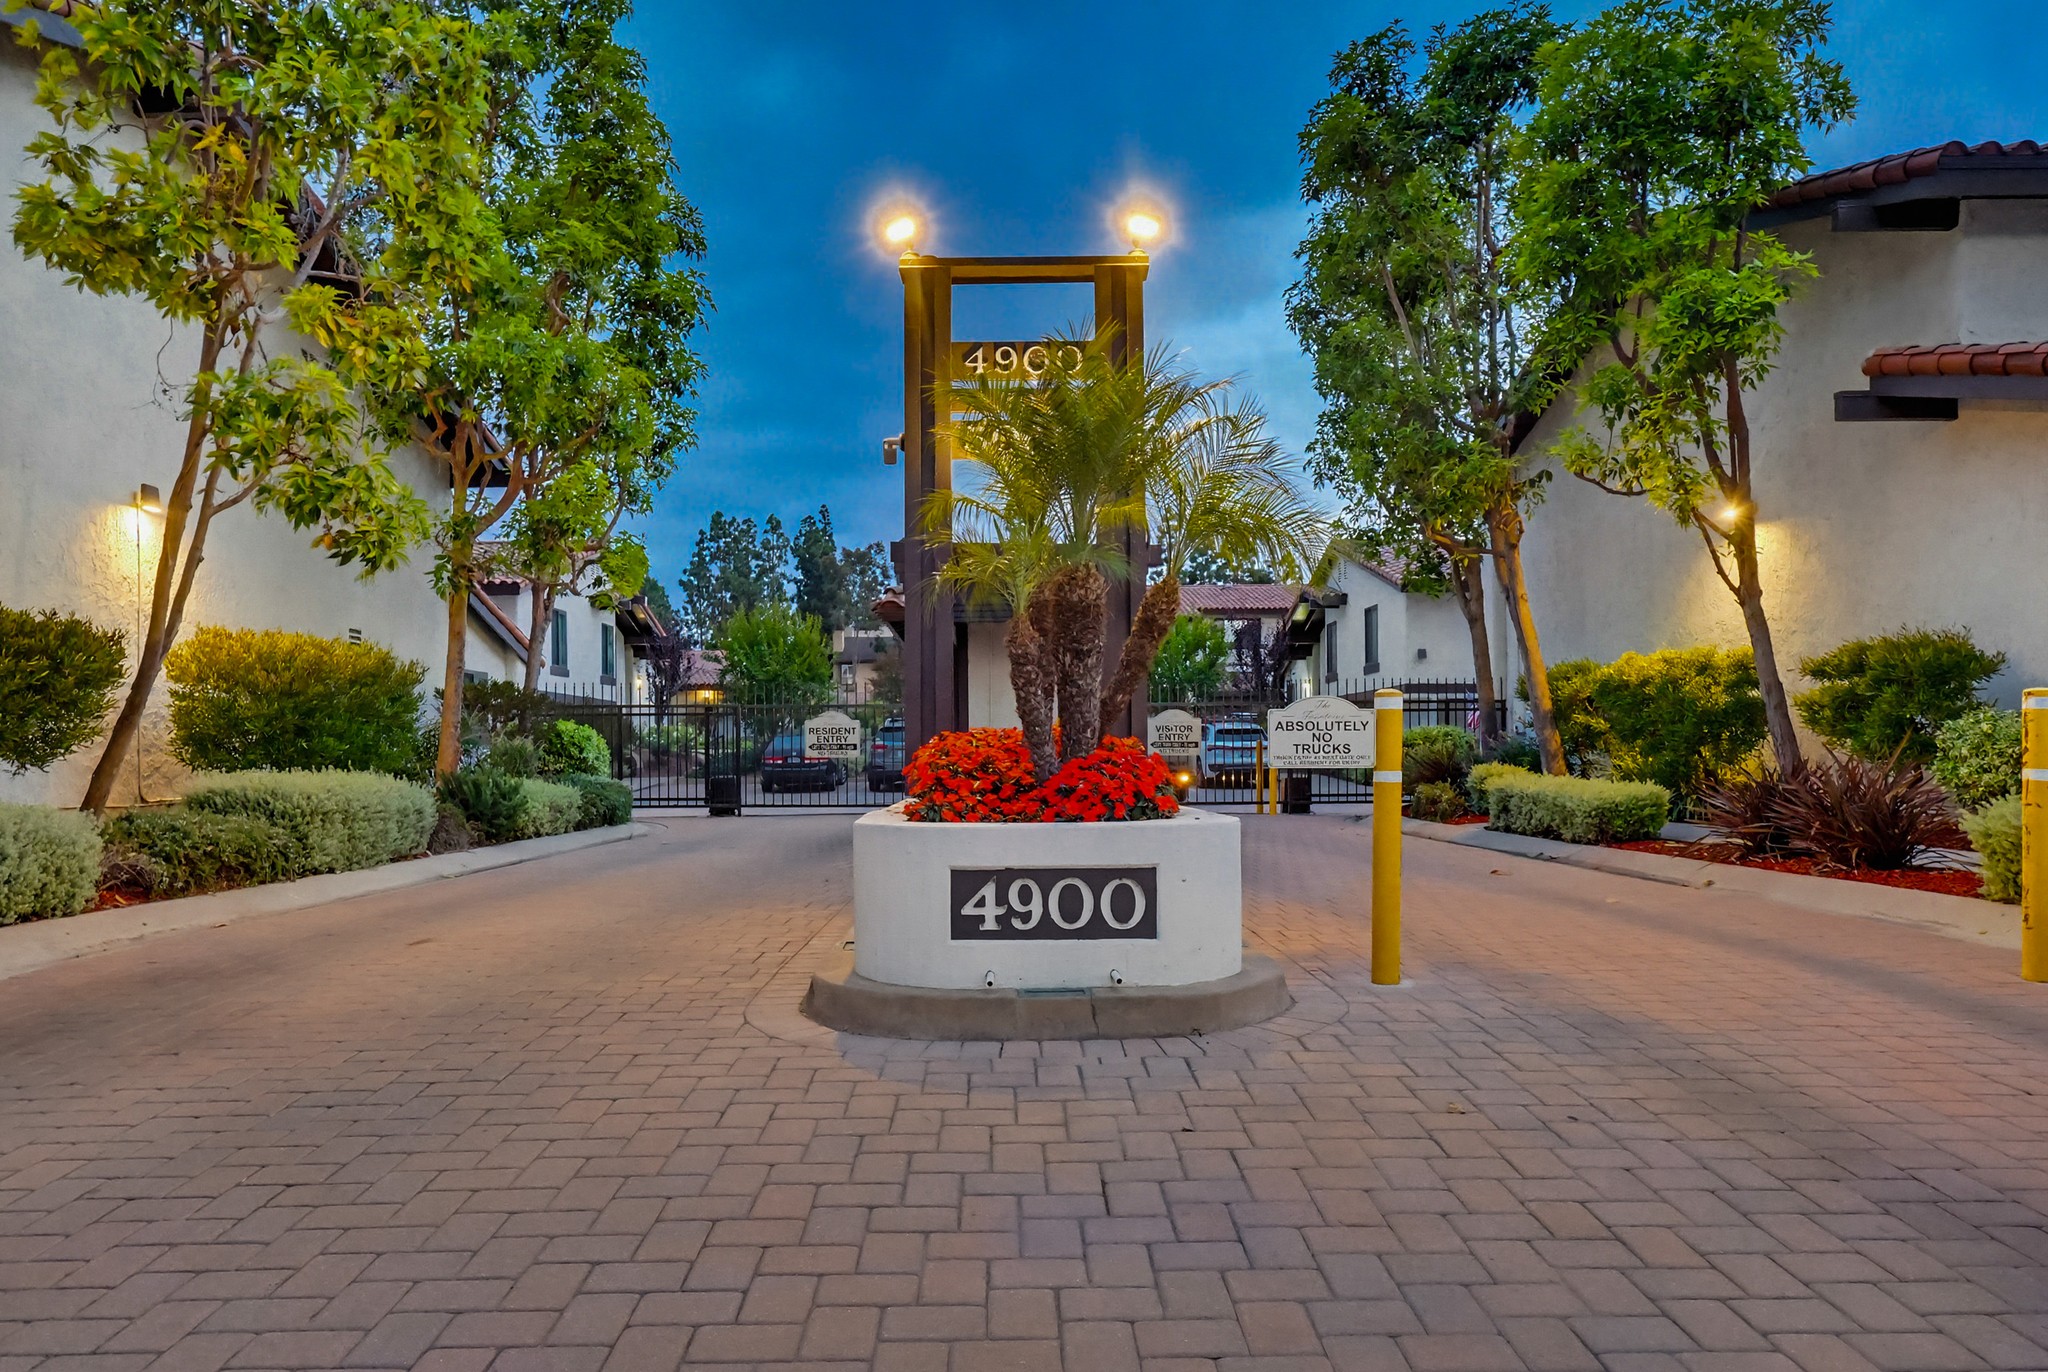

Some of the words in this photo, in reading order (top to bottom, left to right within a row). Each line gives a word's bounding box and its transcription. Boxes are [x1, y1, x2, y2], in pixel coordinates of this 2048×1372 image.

[964, 345, 1084, 375] 4900
[809, 727, 857, 735] RESIDENT
[1155, 725, 1193, 733] VISITOR
[1275, 721, 1369, 731] ABSOLUTELY
[1312, 733, 1333, 742] NO
[1293, 744, 1351, 754] TRUCKS
[961, 876, 1146, 931] 4900
